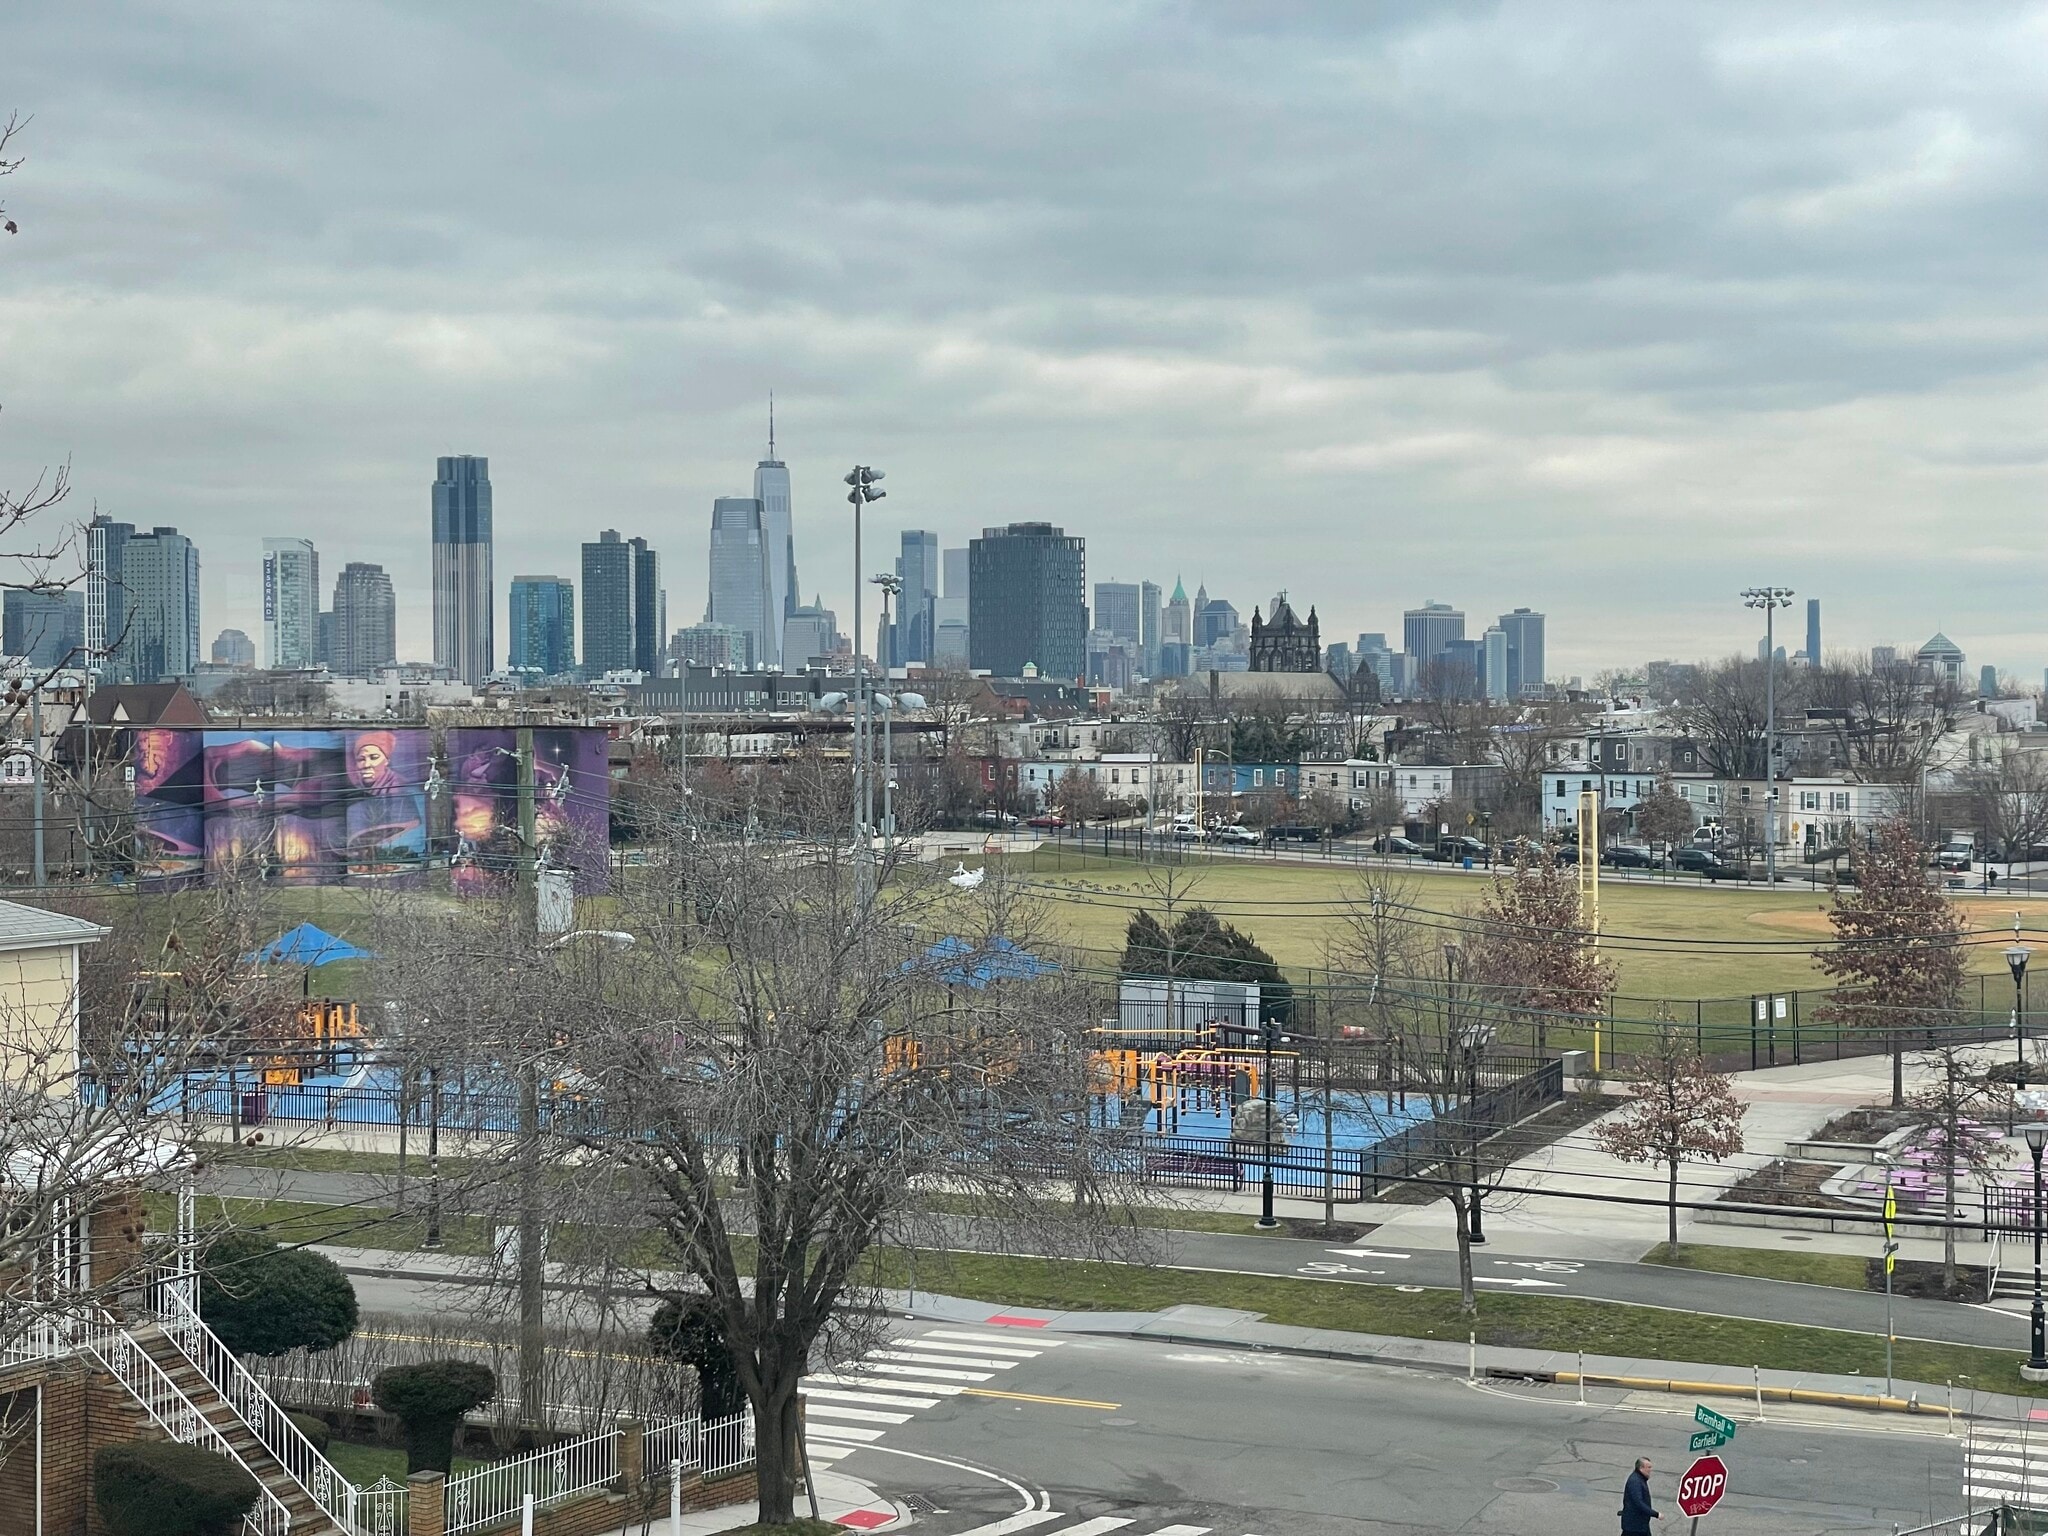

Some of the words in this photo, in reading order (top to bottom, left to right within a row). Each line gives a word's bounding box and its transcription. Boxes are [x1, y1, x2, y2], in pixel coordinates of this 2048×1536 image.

[1697, 1408, 1725, 1432] Bramhall
[1692, 1432, 1717, 1449] Garfield
[1681, 1474, 1724, 1500] STOP
